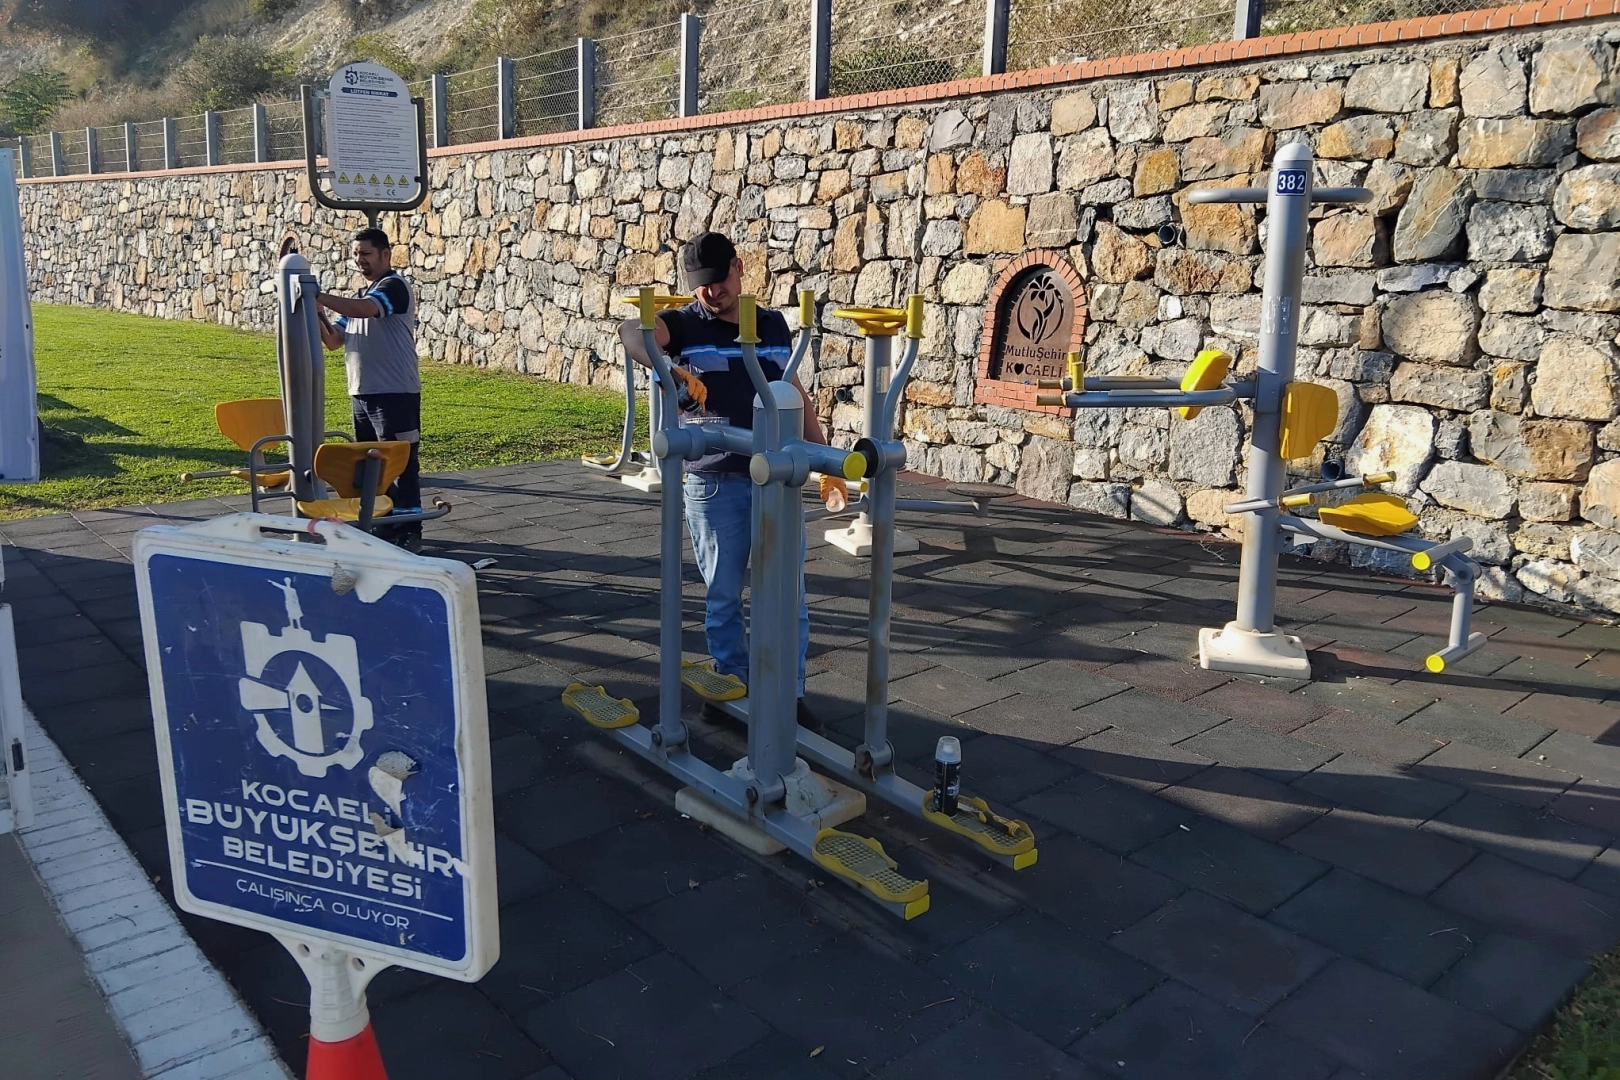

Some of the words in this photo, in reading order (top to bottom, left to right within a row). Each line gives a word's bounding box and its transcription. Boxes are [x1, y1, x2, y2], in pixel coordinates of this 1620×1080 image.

[1278, 174, 1305, 191] 382
[1005, 345, 1067, 361] MutluŞehir
[241, 779, 392, 828] KOCAELİ
[223, 835, 422, 900] BELEDİYESİ
[332, 902, 409, 930] OLUYOR
